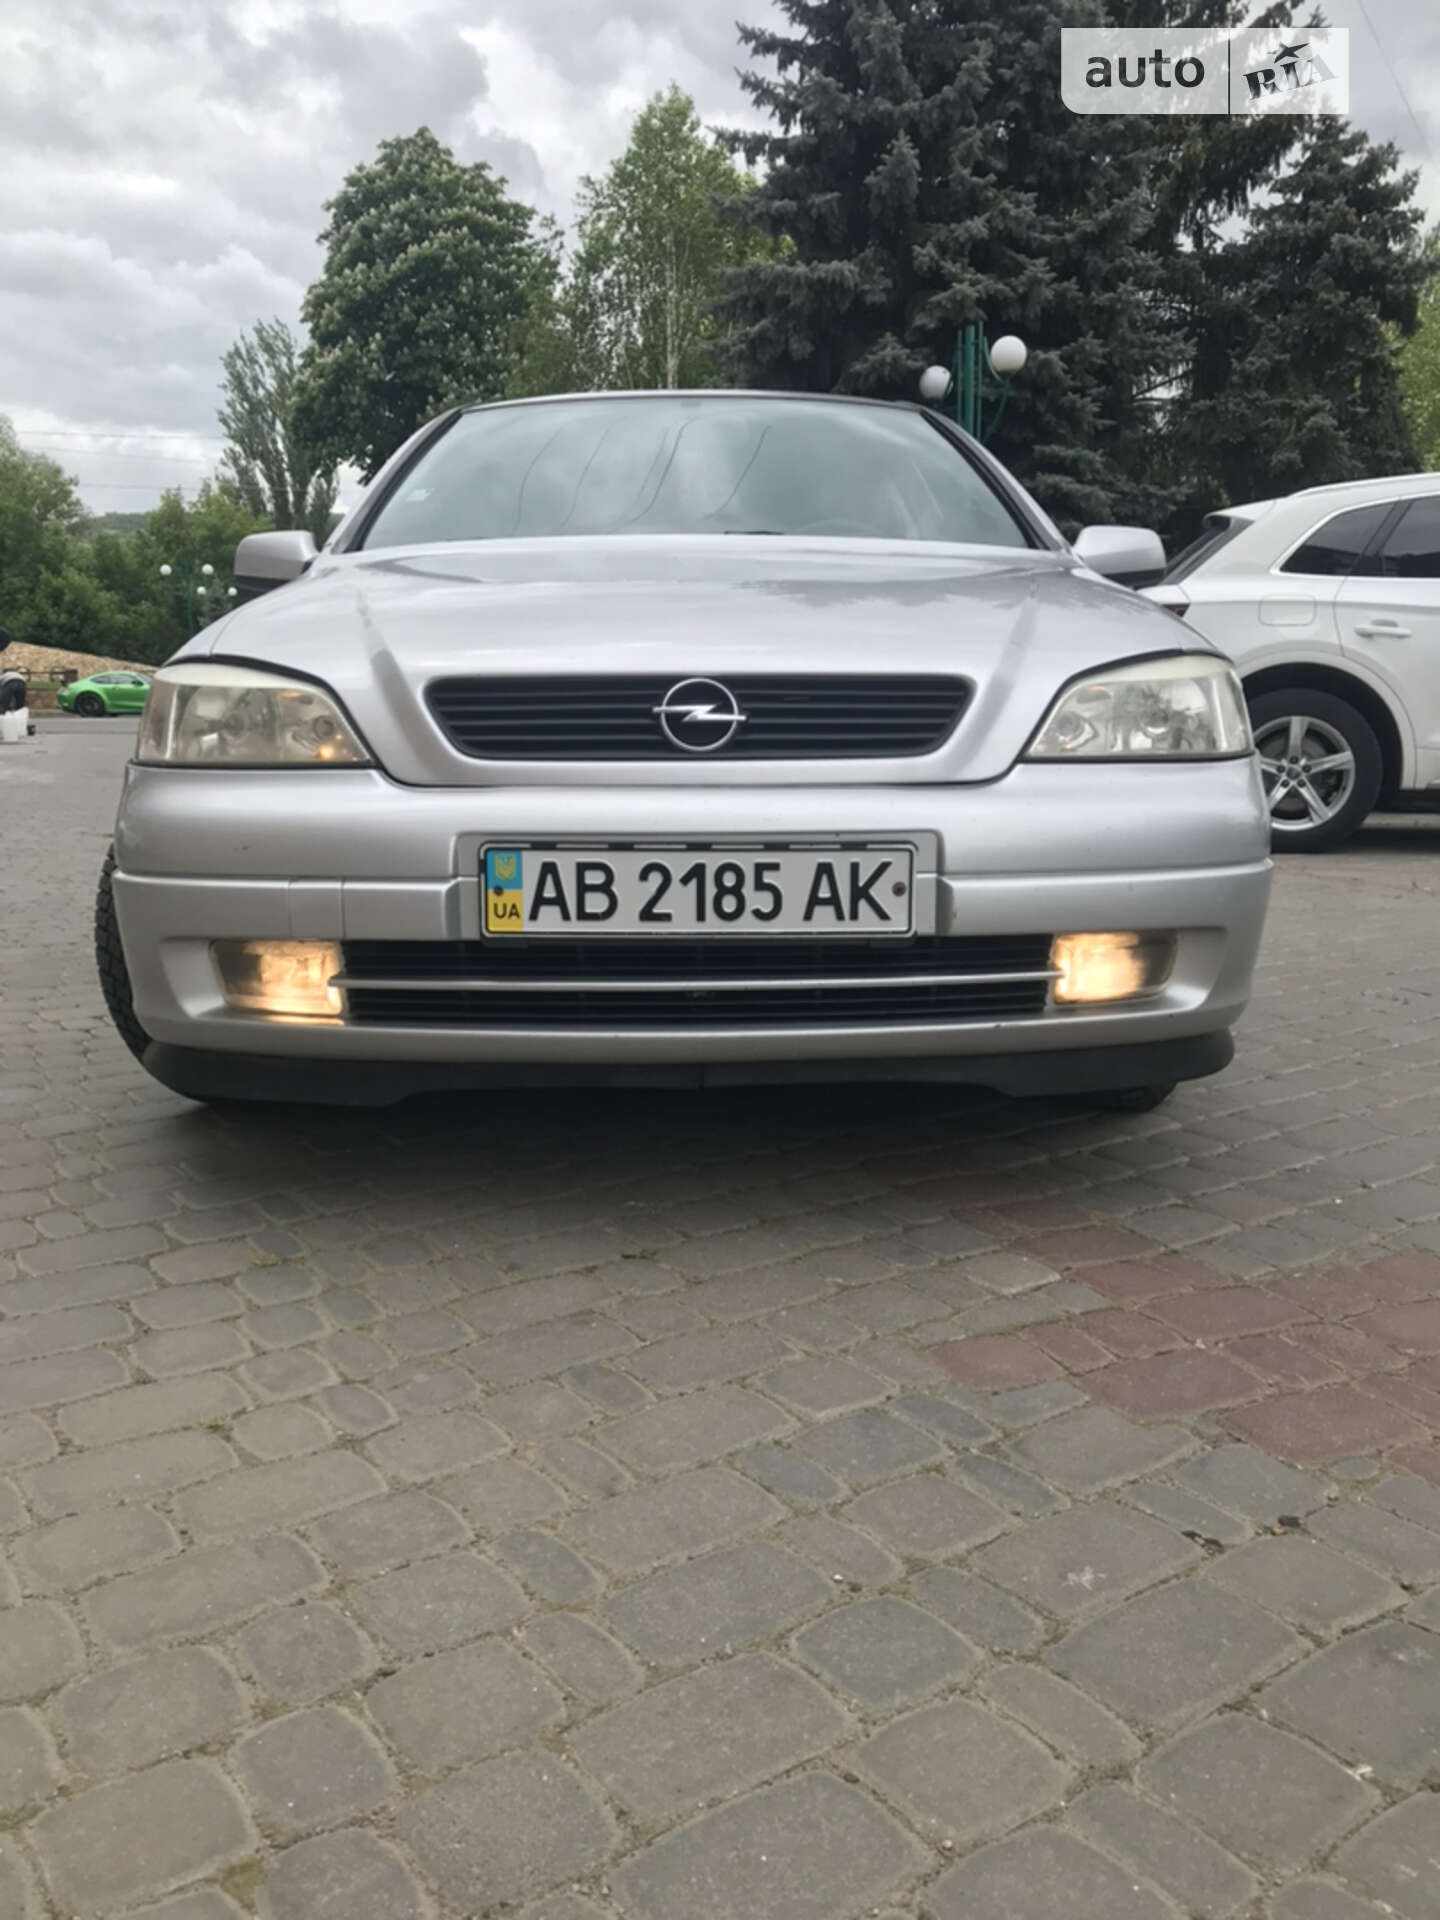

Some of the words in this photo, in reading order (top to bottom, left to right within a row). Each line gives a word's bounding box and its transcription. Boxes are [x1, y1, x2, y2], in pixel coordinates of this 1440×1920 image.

[528, 861, 618, 921] AB
[638, 861, 783, 922] 2185
[803, 861, 892, 921] AK
[493, 903, 521, 919] UA
